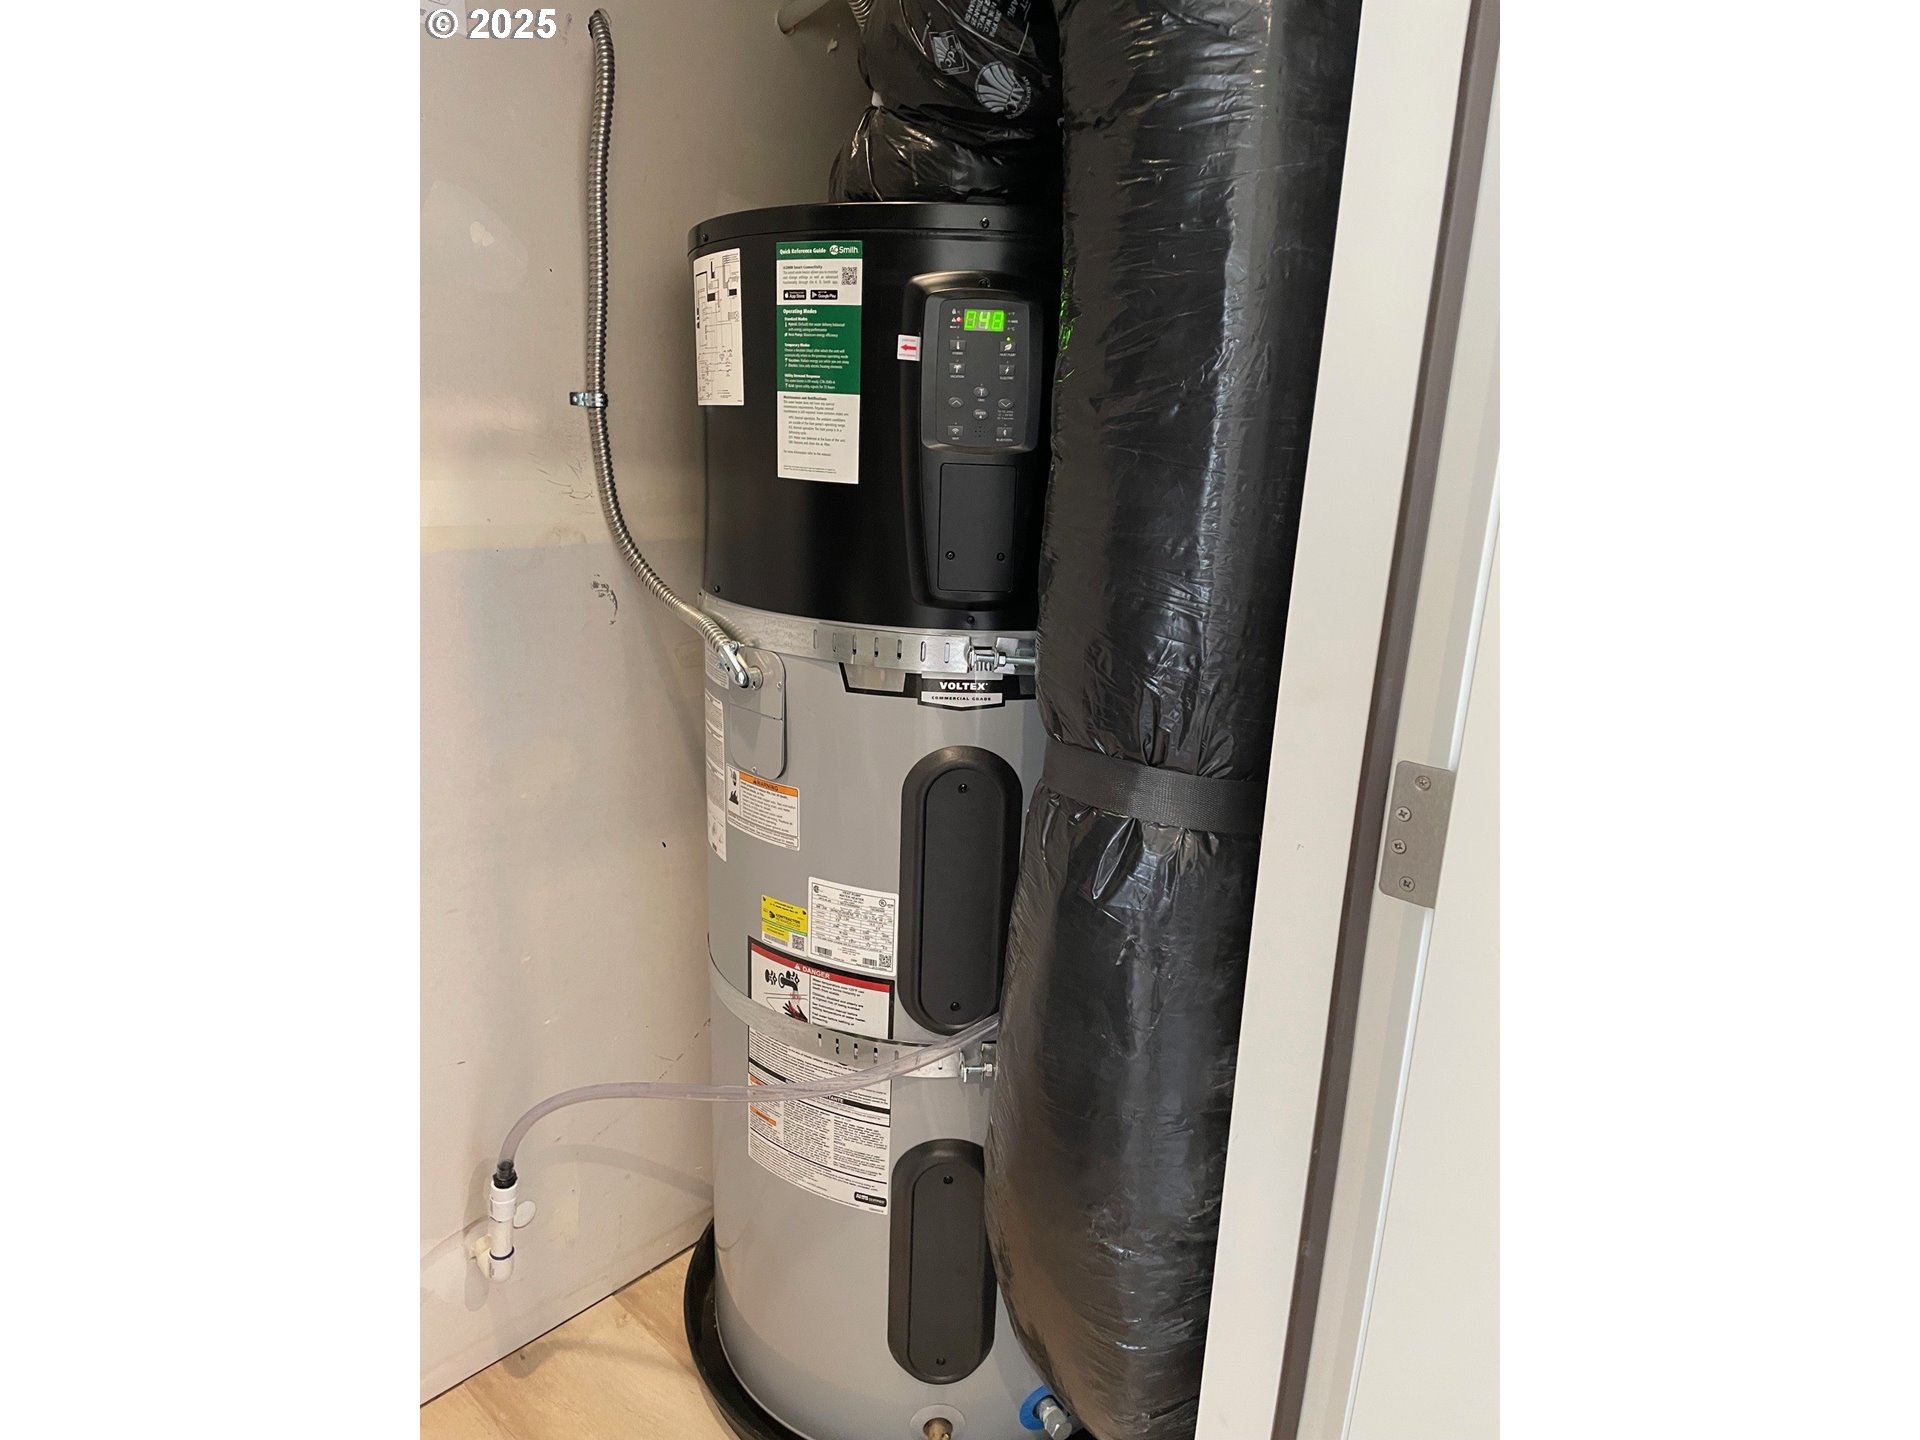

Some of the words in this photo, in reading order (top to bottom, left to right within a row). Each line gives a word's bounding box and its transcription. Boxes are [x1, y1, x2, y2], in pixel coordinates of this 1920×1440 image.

[939, 682, 986, 690] VOLTEX
[756, 781, 778, 791] WARNING
[802, 967, 830, 979] DANGER
